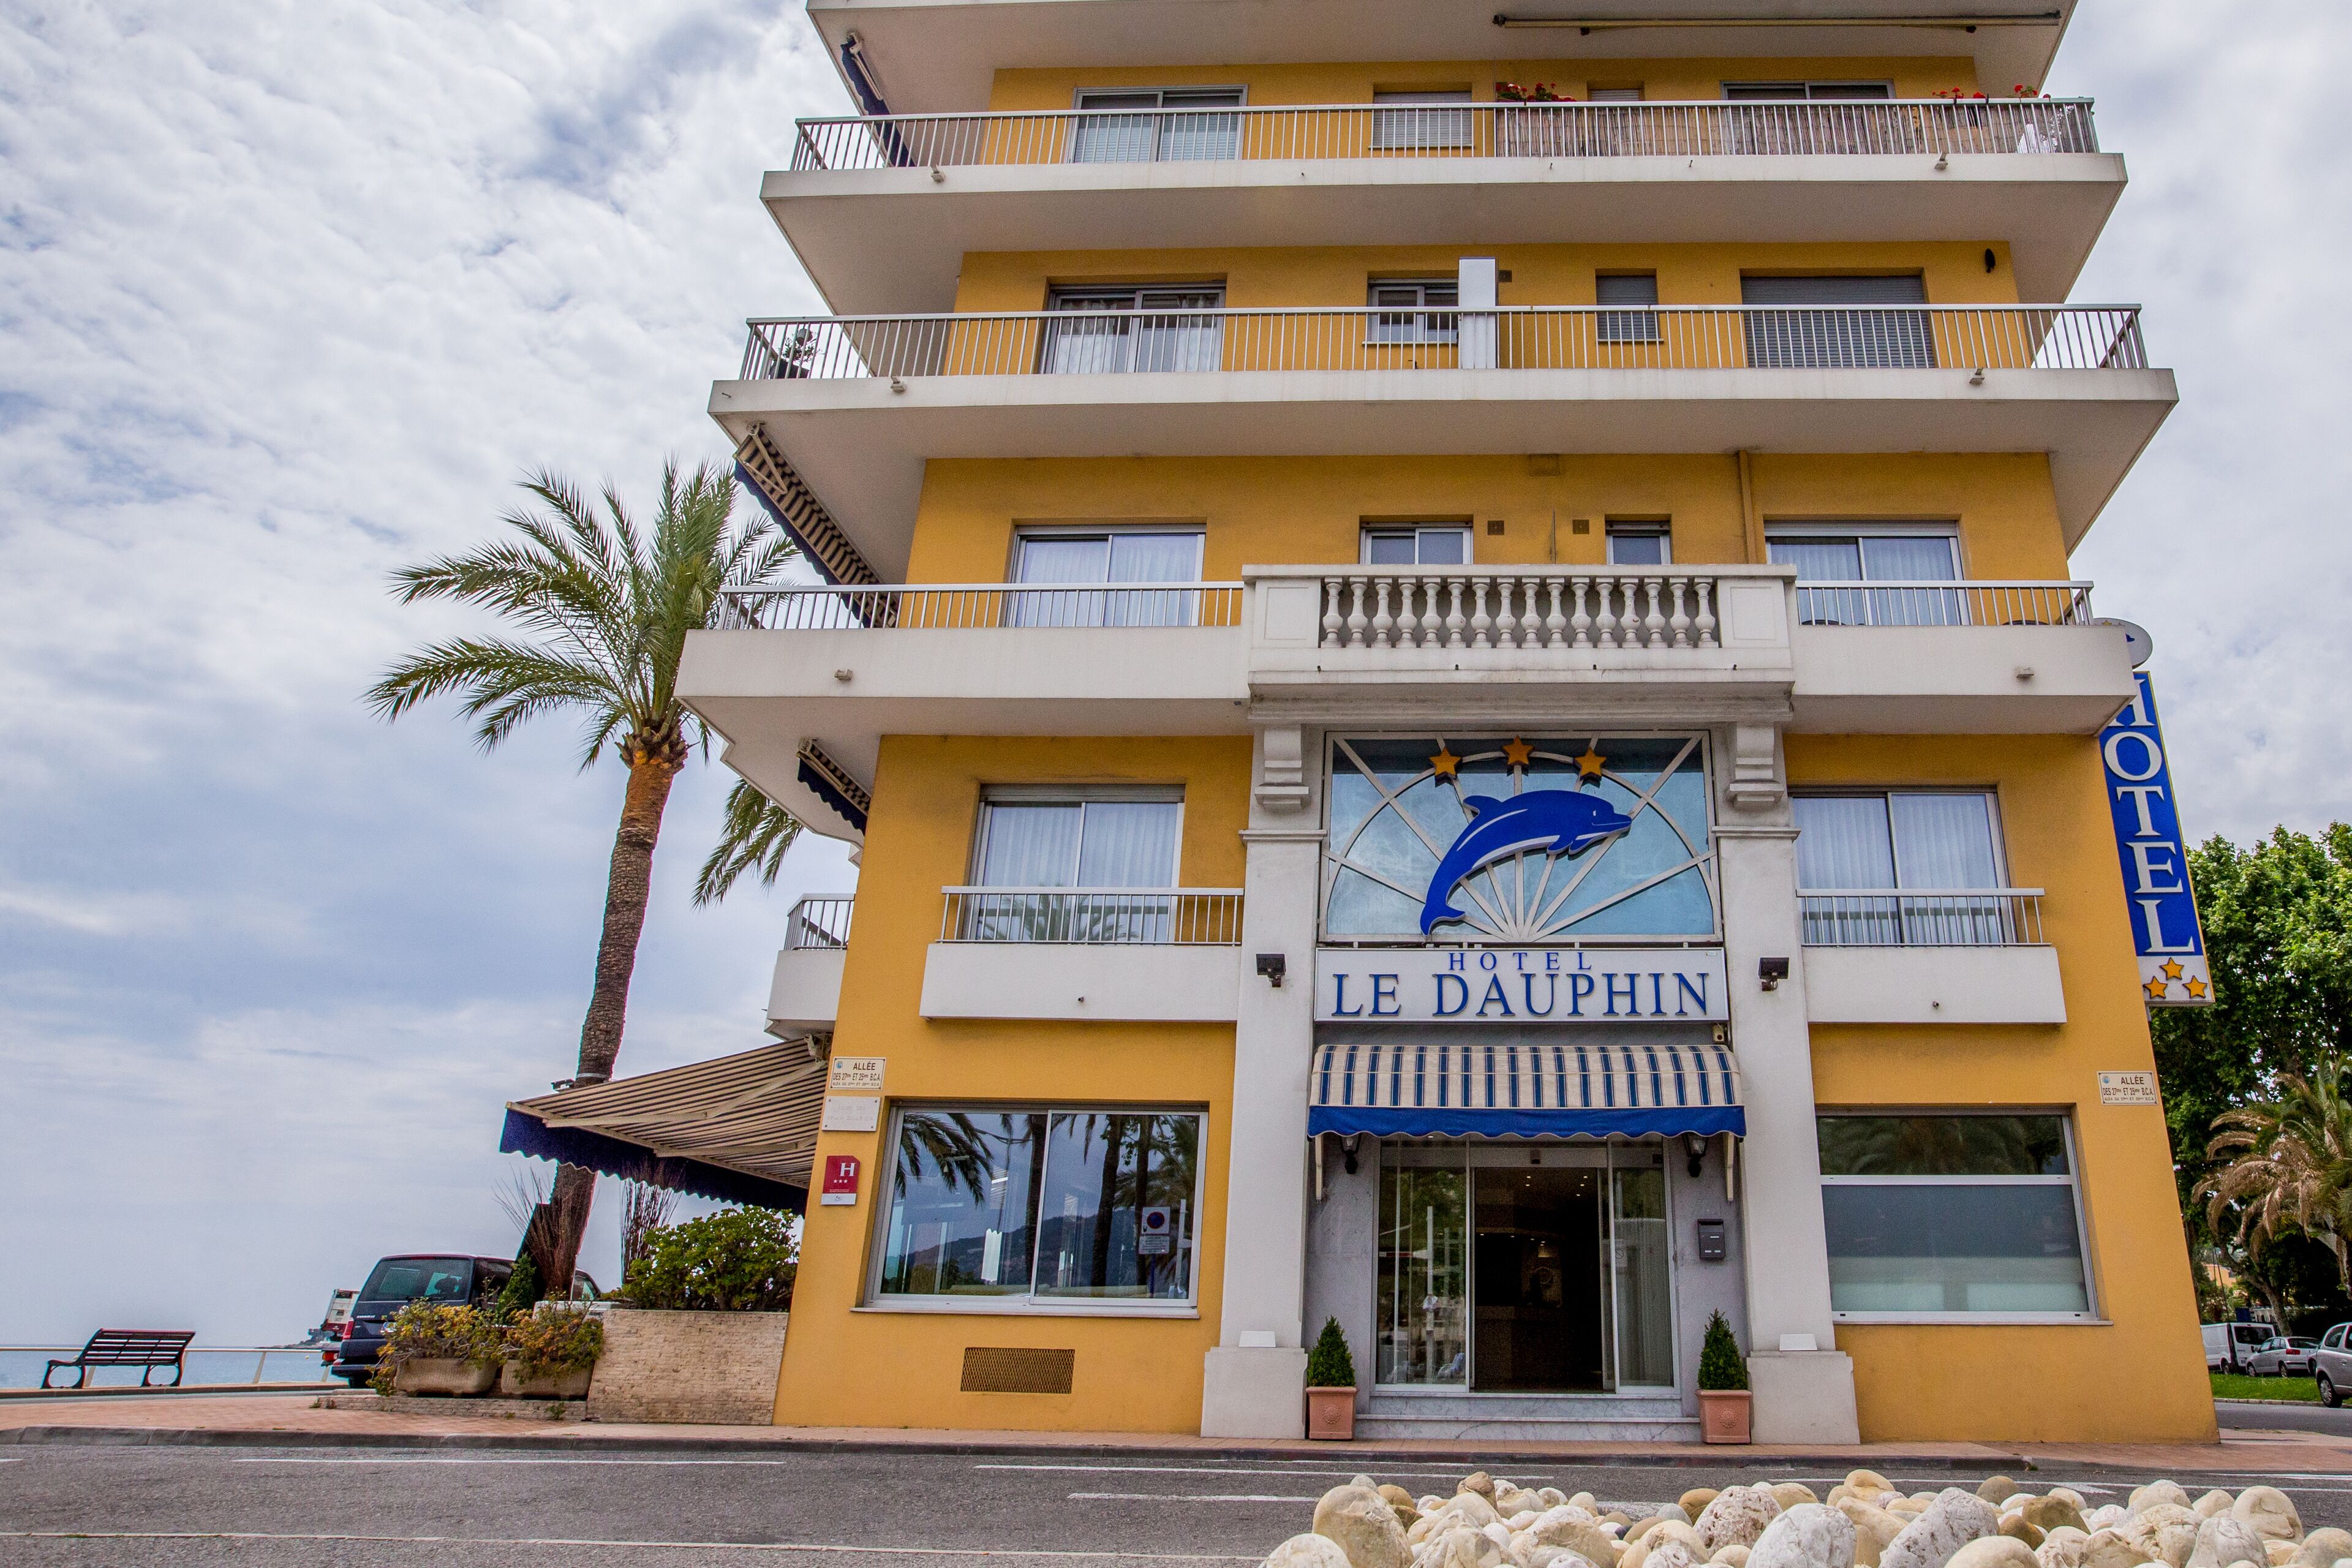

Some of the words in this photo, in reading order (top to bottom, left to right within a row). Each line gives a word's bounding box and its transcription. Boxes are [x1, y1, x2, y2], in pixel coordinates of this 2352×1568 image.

[1448, 952, 1592, 970] HOTEL
[1331, 973, 1403, 1016] LE
[1432, 972, 1709, 1016] DAUPHIN
[853, 1061, 876, 1070] ALLÉE
[2121, 1075, 2144, 1085] ALLÉE
[840, 1163, 856, 1177] H
